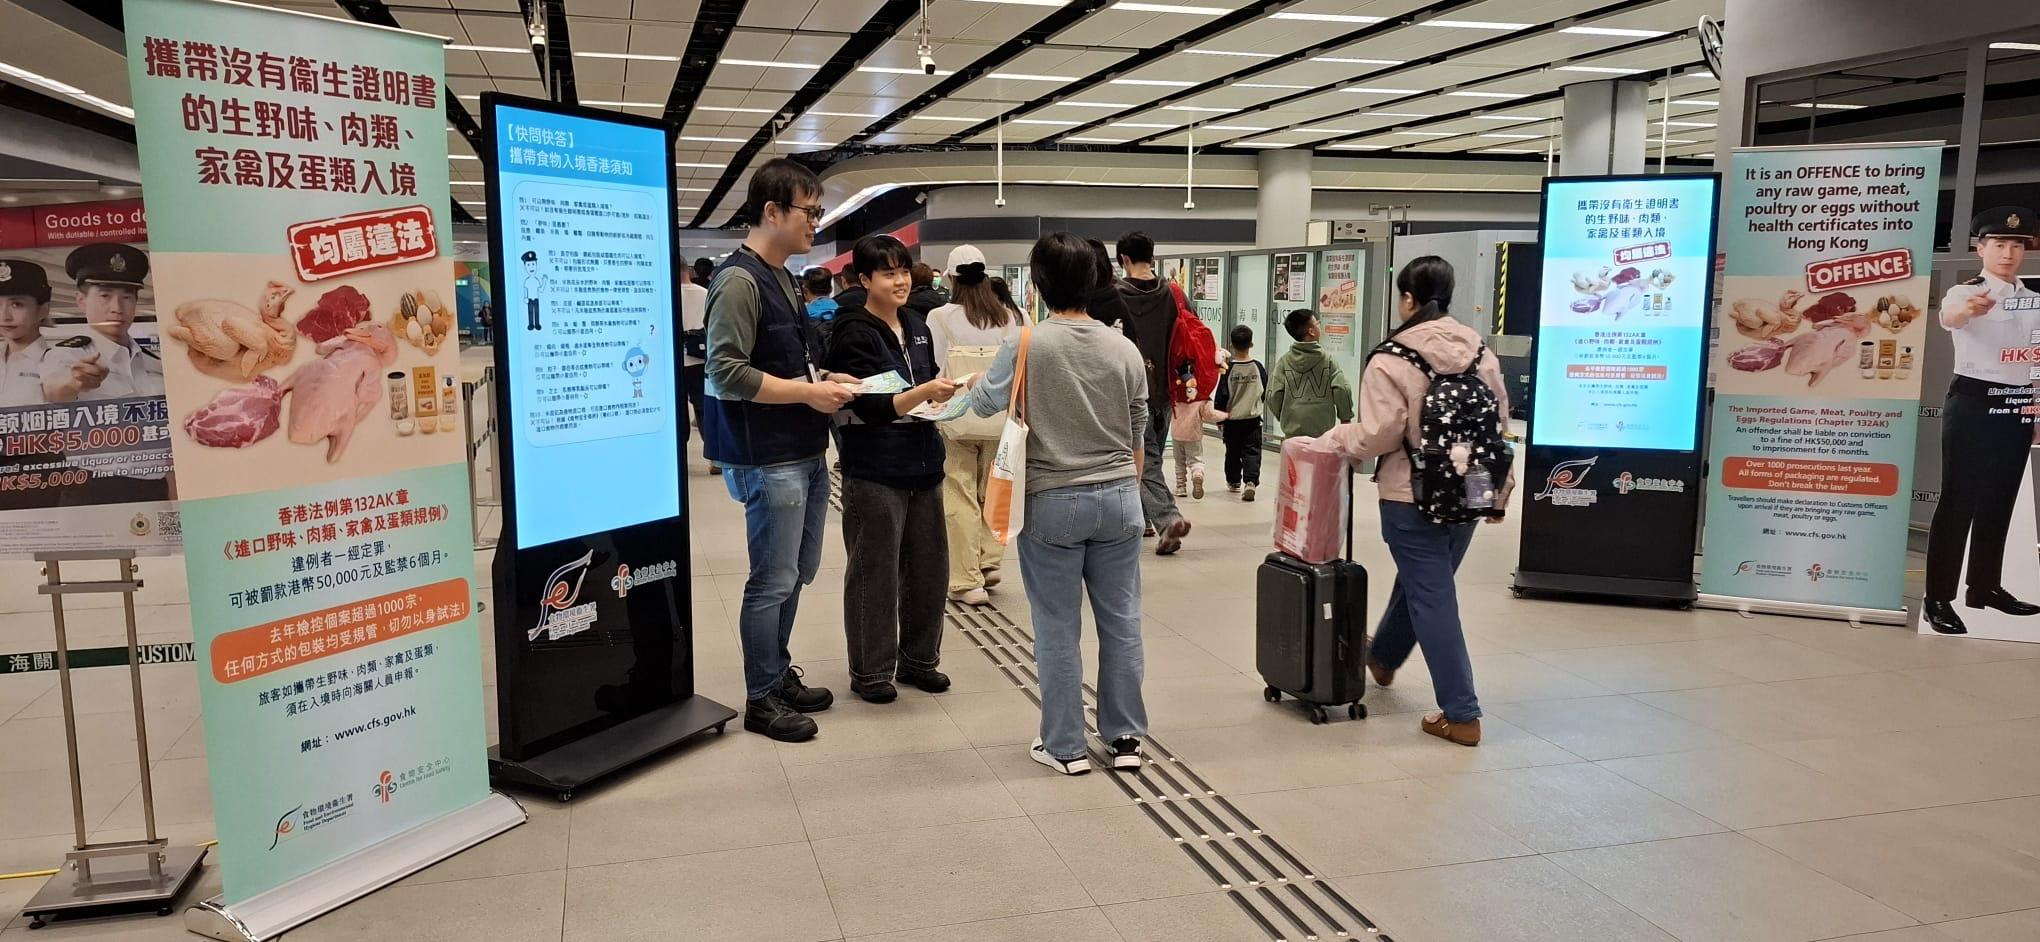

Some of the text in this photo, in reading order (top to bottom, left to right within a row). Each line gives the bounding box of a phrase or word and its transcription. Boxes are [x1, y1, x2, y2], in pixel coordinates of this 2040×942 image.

[181, 93, 415, 150] 的生野味、肉類、
[508, 123, 574, 149] 【快問快答】
[509, 146, 633, 176] 攜帶食物入境香港須知
[195, 146, 417, 197] 家禽及蛋類入境
[1745, 163, 1926, 180] It is an OFFENCE to bring
[1755, 182, 1910, 201] any raw game, meat,
[1745, 200, 1920, 218] poultry or eggs without
[45, 212, 101, 229] Goods
[106, 211, 125, 225] to
[1748, 217, 1913, 232] health certificates into
[48, 232, 64, 240] With
[65, 230, 94, 239] dutiable
[100, 227, 136, 237] controlled
[309, 218, 427, 266] 均屬違法
[1788, 236, 1868, 252] Hong Kong
[1815, 256, 1904, 285] OFFENCE
[1728, 405, 1744, 413] The
[1746, 406, 1787, 416] Imported
[1790, 407, 1818, 416] Game,
[1849, 409, 1882, 419] Poultry
[1884, 410, 1902, 418] and
[1736, 415, 1889, 428] Eggs Regulations (Chapter 132AK)
[6, 425, 141, 457] HK$5,000
[1748, 427, 1781, 435] offender
[1815, 429, 1836, 437] liable
[1850, 430, 1891, 439] conviction
[1777, 436, 1792, 444] fine
[1804, 438, 1847, 447] HK$50,000
[1848, 439, 1864, 447] and
[1752, 444, 1761, 452] to
[1763, 445, 1816, 454] imprisonment
[23, 459, 79, 472] excessive
[117, 454, 129, 463] or
[1745, 460, 1765, 469] Over
[1767, 461, 1785, 469] 1000
[1786, 462, 1836, 471] prosecutions
[1838, 464, 1852, 472] last
[0, 469, 88, 491] K$5,000
[92, 469, 114, 479] fine
[116, 468, 128, 476] to
[1738, 469, 1749, 477] All
[1751, 470, 1773, 478] forms
[1774, 470, 1784, 478] of
[1785, 472, 1825, 482] packaging
[1840, 474, 1880, 484] regulated.
[1768, 479, 1848, 491] Don't break the law!
[278, 488, 410, 527] 香港法例第132AK章
[1728, 494, 1755, 503] Travellers
[1756, 496, 1776, 504] should
[1777, 497, 1794, 505] make
[1795, 498, 1828, 507] declaration
[1837, 500, 1863, 509] Customs
[1864, 502, 1888, 510] Officers
[1780, 505, 1793, 513] they
[1805, 506, 1831, 515] bringing
[1832, 508, 1843, 516] any
[1791, 513, 1813, 521] poultry
[1785, 529, 1847, 540] www.cfs.gov.hk
[9, 653, 53, 673] 海關
[334, 704, 417, 742] www.cfs.gov.hk
